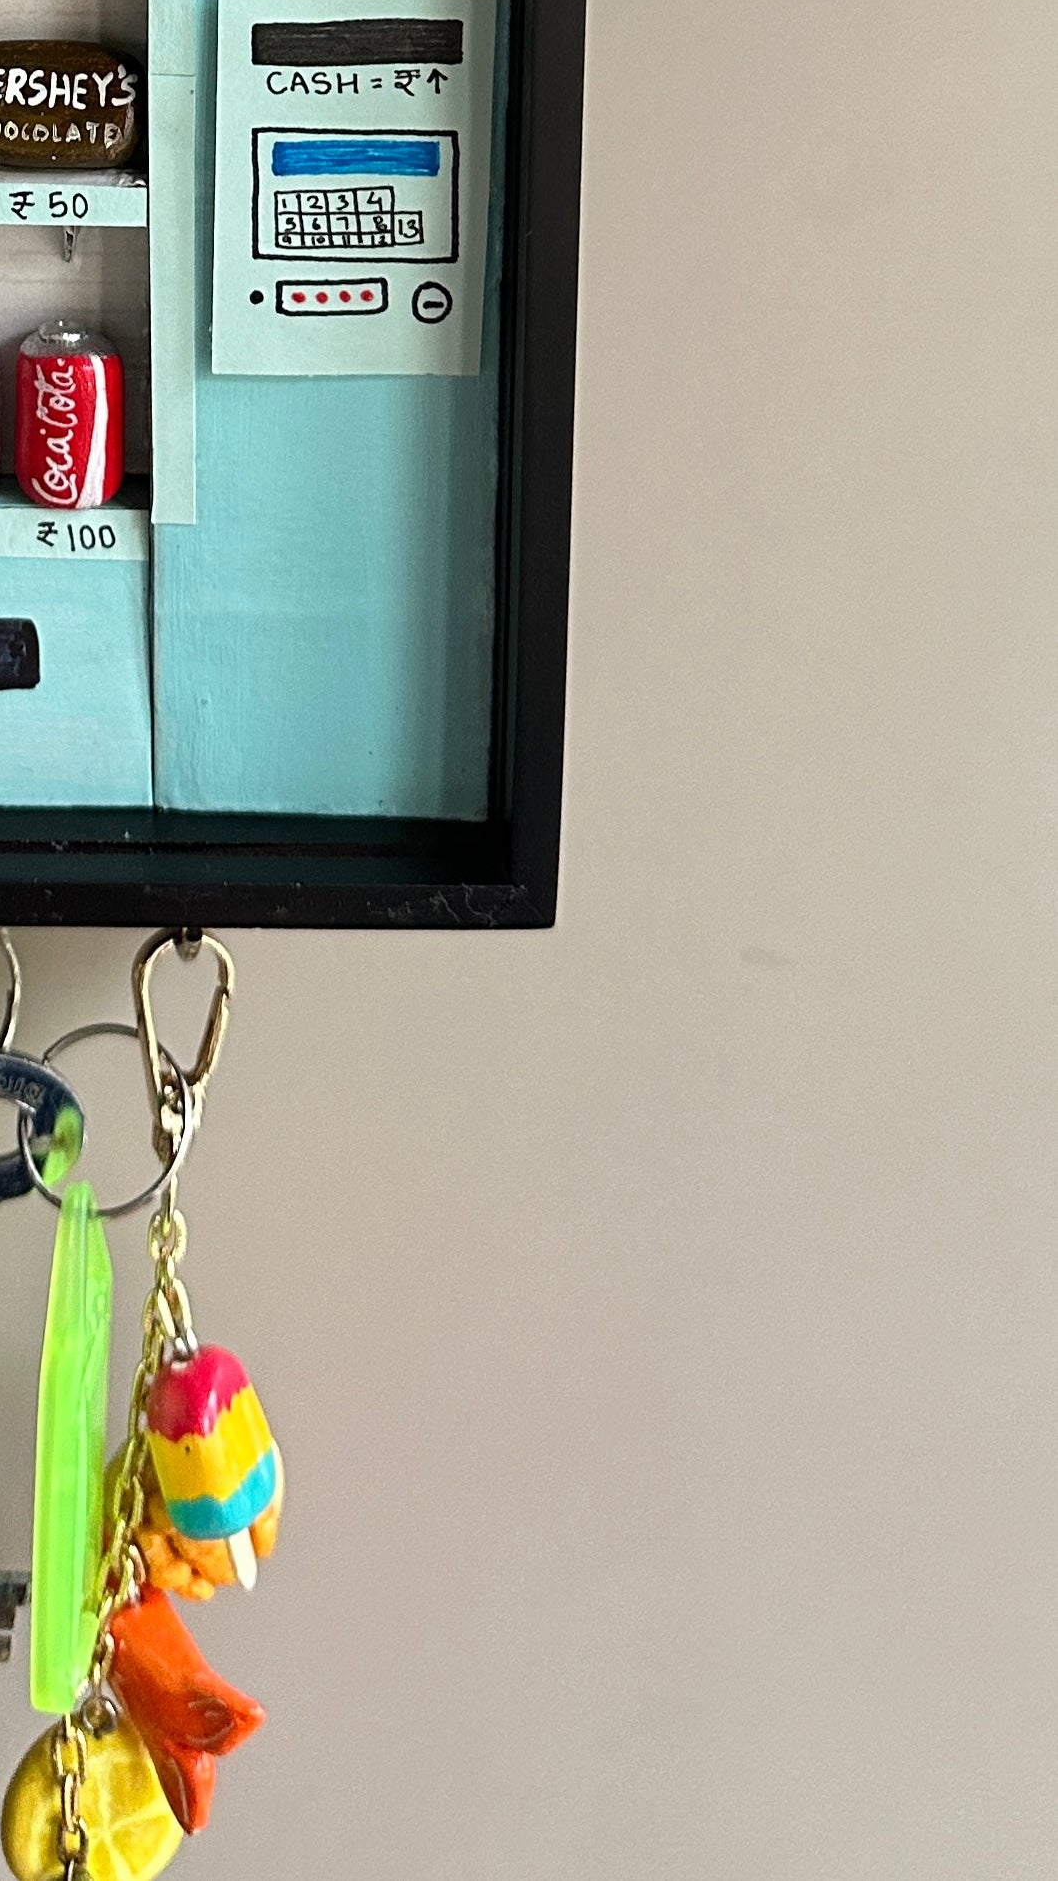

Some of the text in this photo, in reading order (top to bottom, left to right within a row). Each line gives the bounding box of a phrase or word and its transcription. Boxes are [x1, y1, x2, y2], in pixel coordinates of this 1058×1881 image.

[266, 72, 359, 95] CASH
[306, 195, 323, 209] 2
[336, 194, 350, 210] 3
[366, 191, 383, 212] 4
[311, 217, 322, 230] 6
[336, 216, 349, 230] 7
[397, 218, 420, 239] 13
